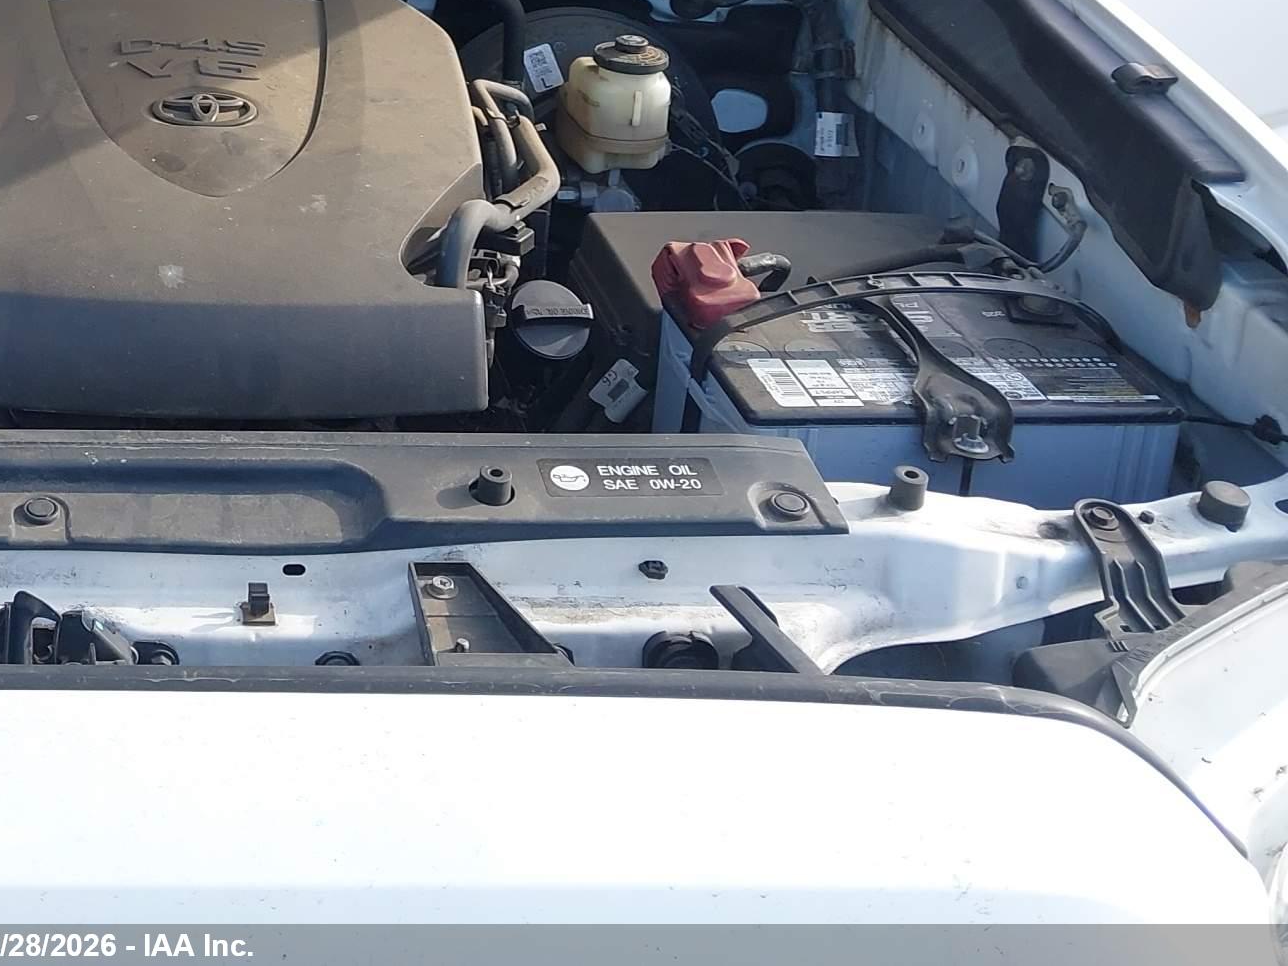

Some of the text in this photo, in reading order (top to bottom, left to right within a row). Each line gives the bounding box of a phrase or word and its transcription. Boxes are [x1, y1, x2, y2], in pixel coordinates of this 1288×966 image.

[596, 465, 698, 476] ENGINE OIL
[603, 479, 702, 490] SAE 0W-20
